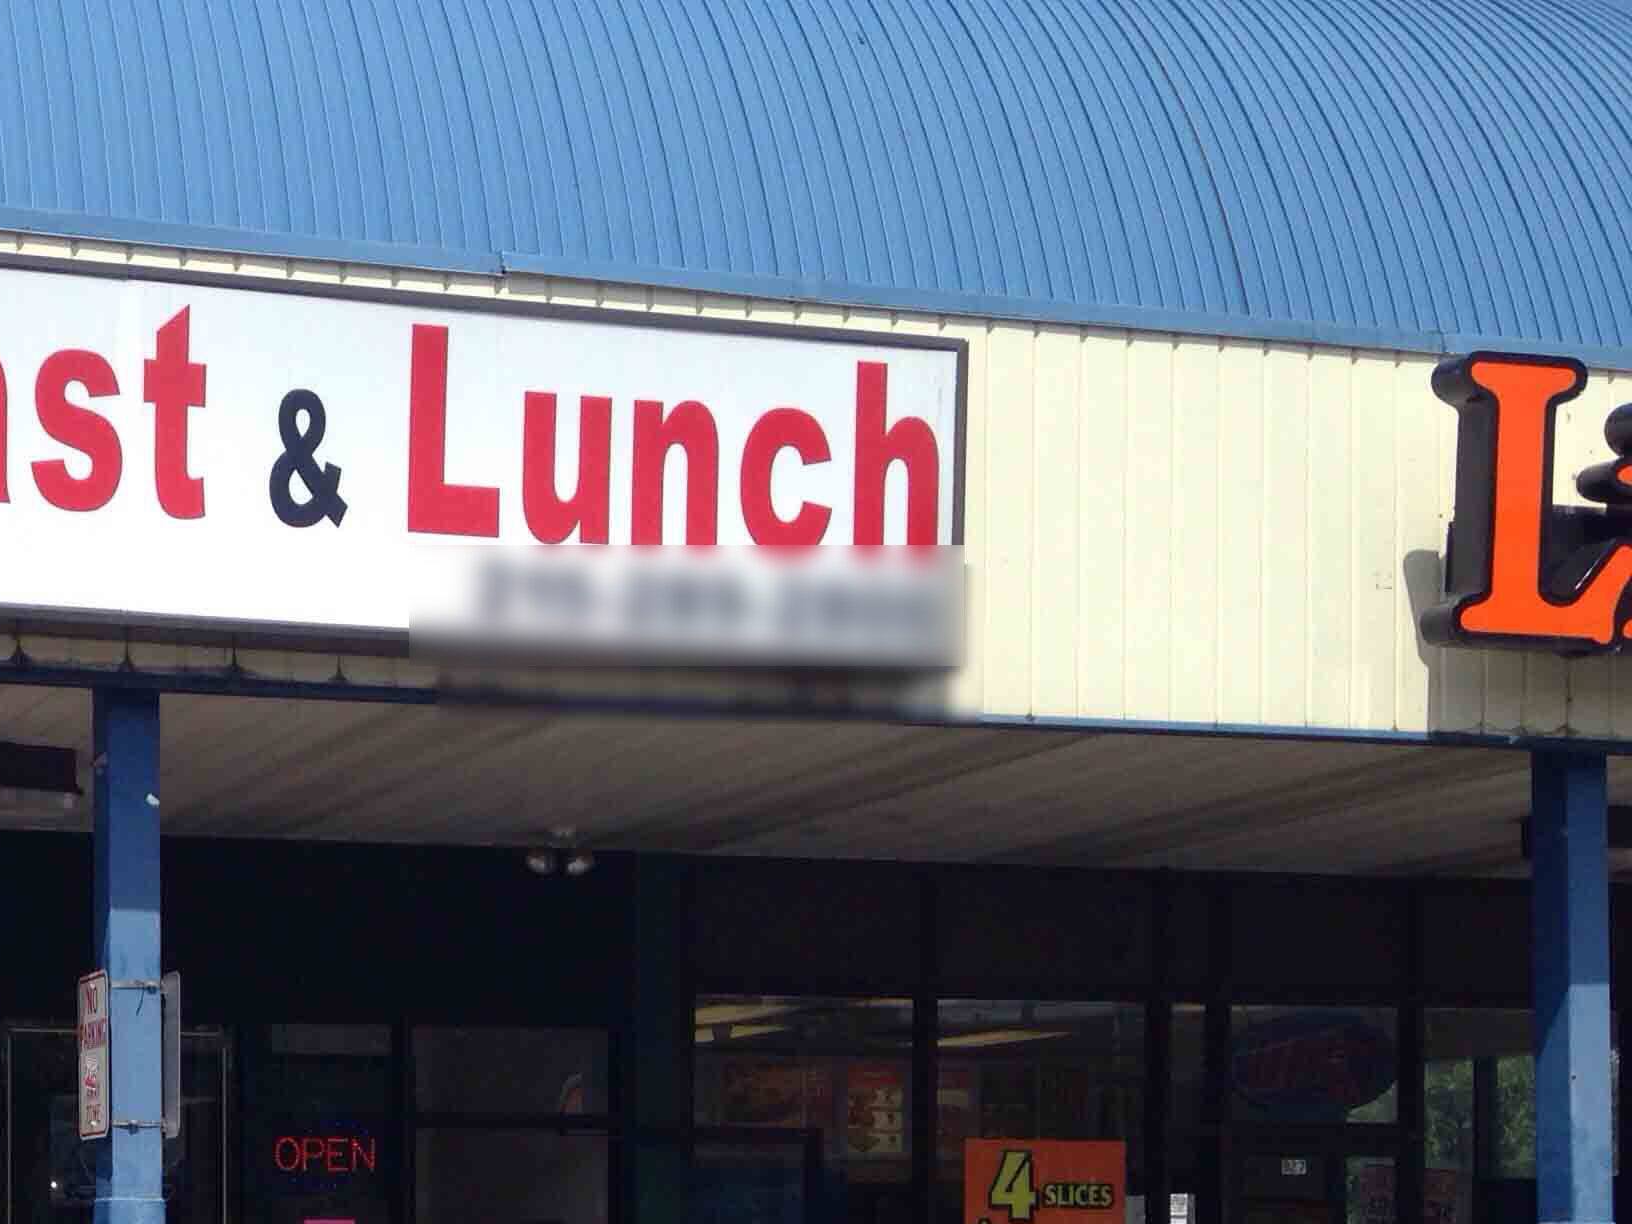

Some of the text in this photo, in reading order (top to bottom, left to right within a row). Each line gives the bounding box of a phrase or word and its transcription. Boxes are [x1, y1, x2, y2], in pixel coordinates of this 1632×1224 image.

[268, 388, 349, 529] &
[407, 323, 941, 560] Lunch
[85, 986, 98, 1015] NO
[272, 1136, 377, 1174] OPEN
[990, 1149, 1113, 1222] 4 SLICES
